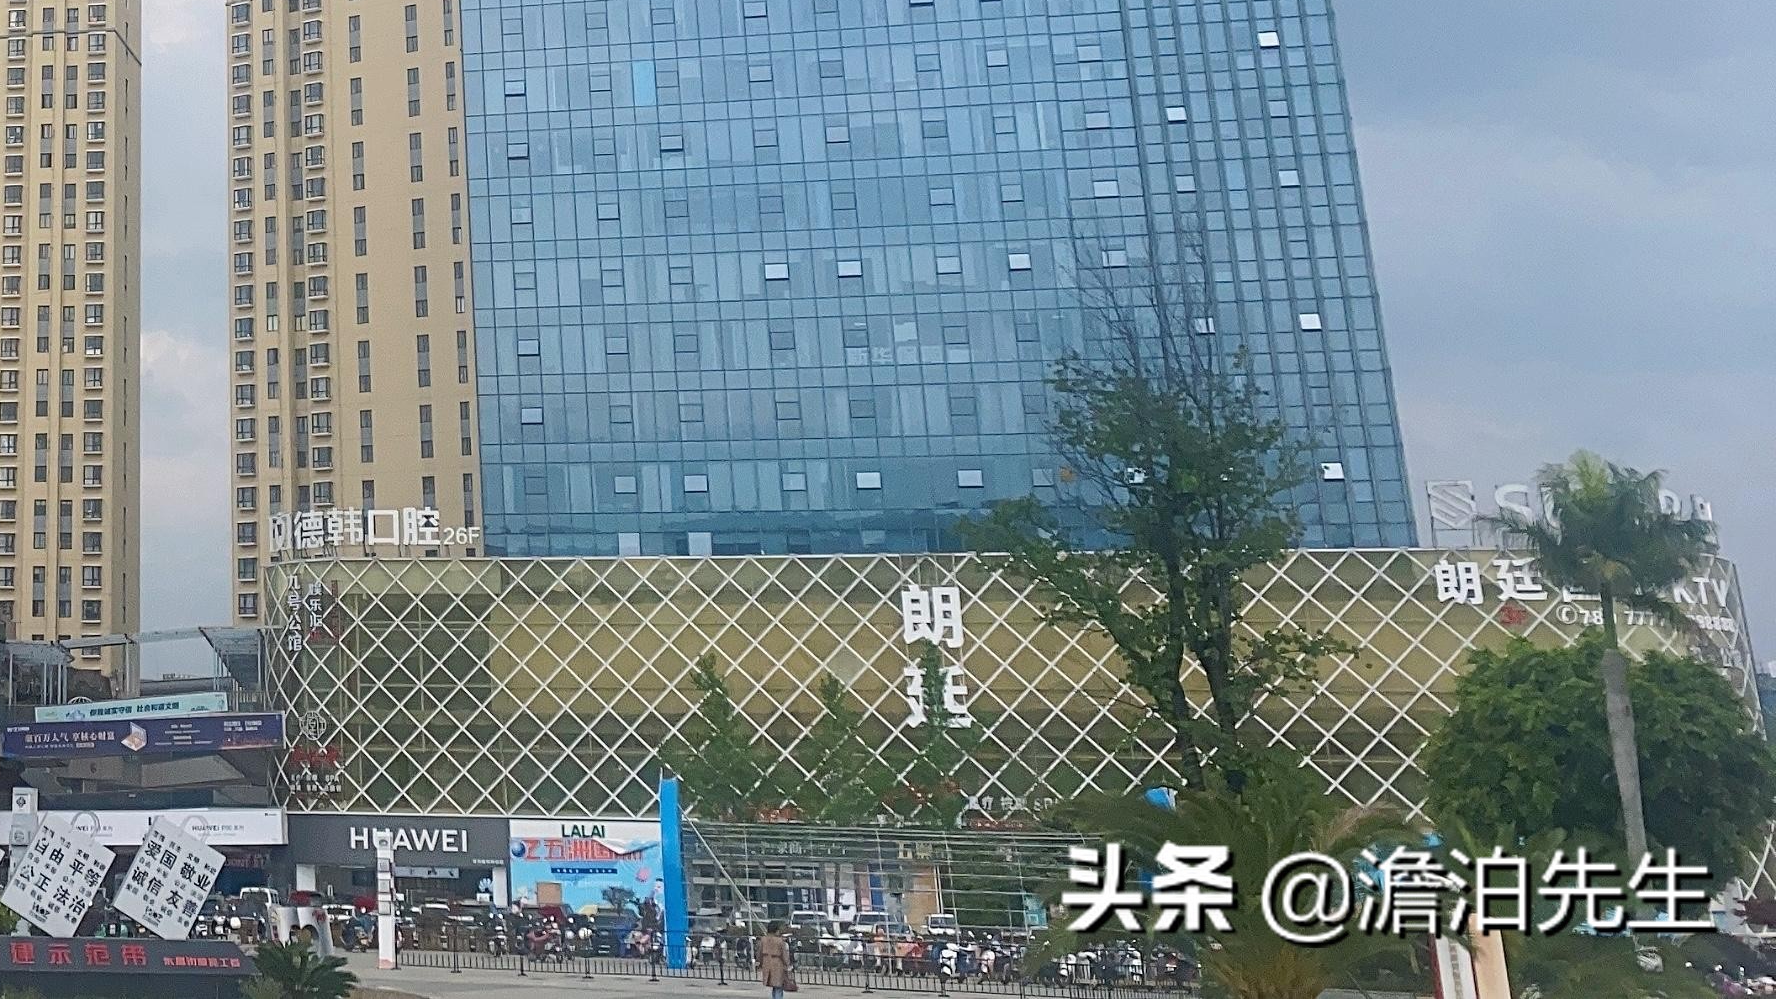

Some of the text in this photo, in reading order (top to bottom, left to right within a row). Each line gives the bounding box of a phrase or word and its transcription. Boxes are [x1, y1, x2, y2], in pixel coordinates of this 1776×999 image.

[293, 507, 481, 550] 德韩口腔 26F
[1435, 557, 1549, 605] 朗廷
[287, 574, 303, 651] 九号公馆
[561, 824, 605, 838] LALAI
[34, 837, 101, 887] 自由 平等
[144, 840, 177, 870] 爱国
[180, 862, 211, 892] 敬业
[19, 864, 52, 893] 公正
[53, 885, 86, 916] 法治
[131, 866, 199, 919] 诚信 友善
